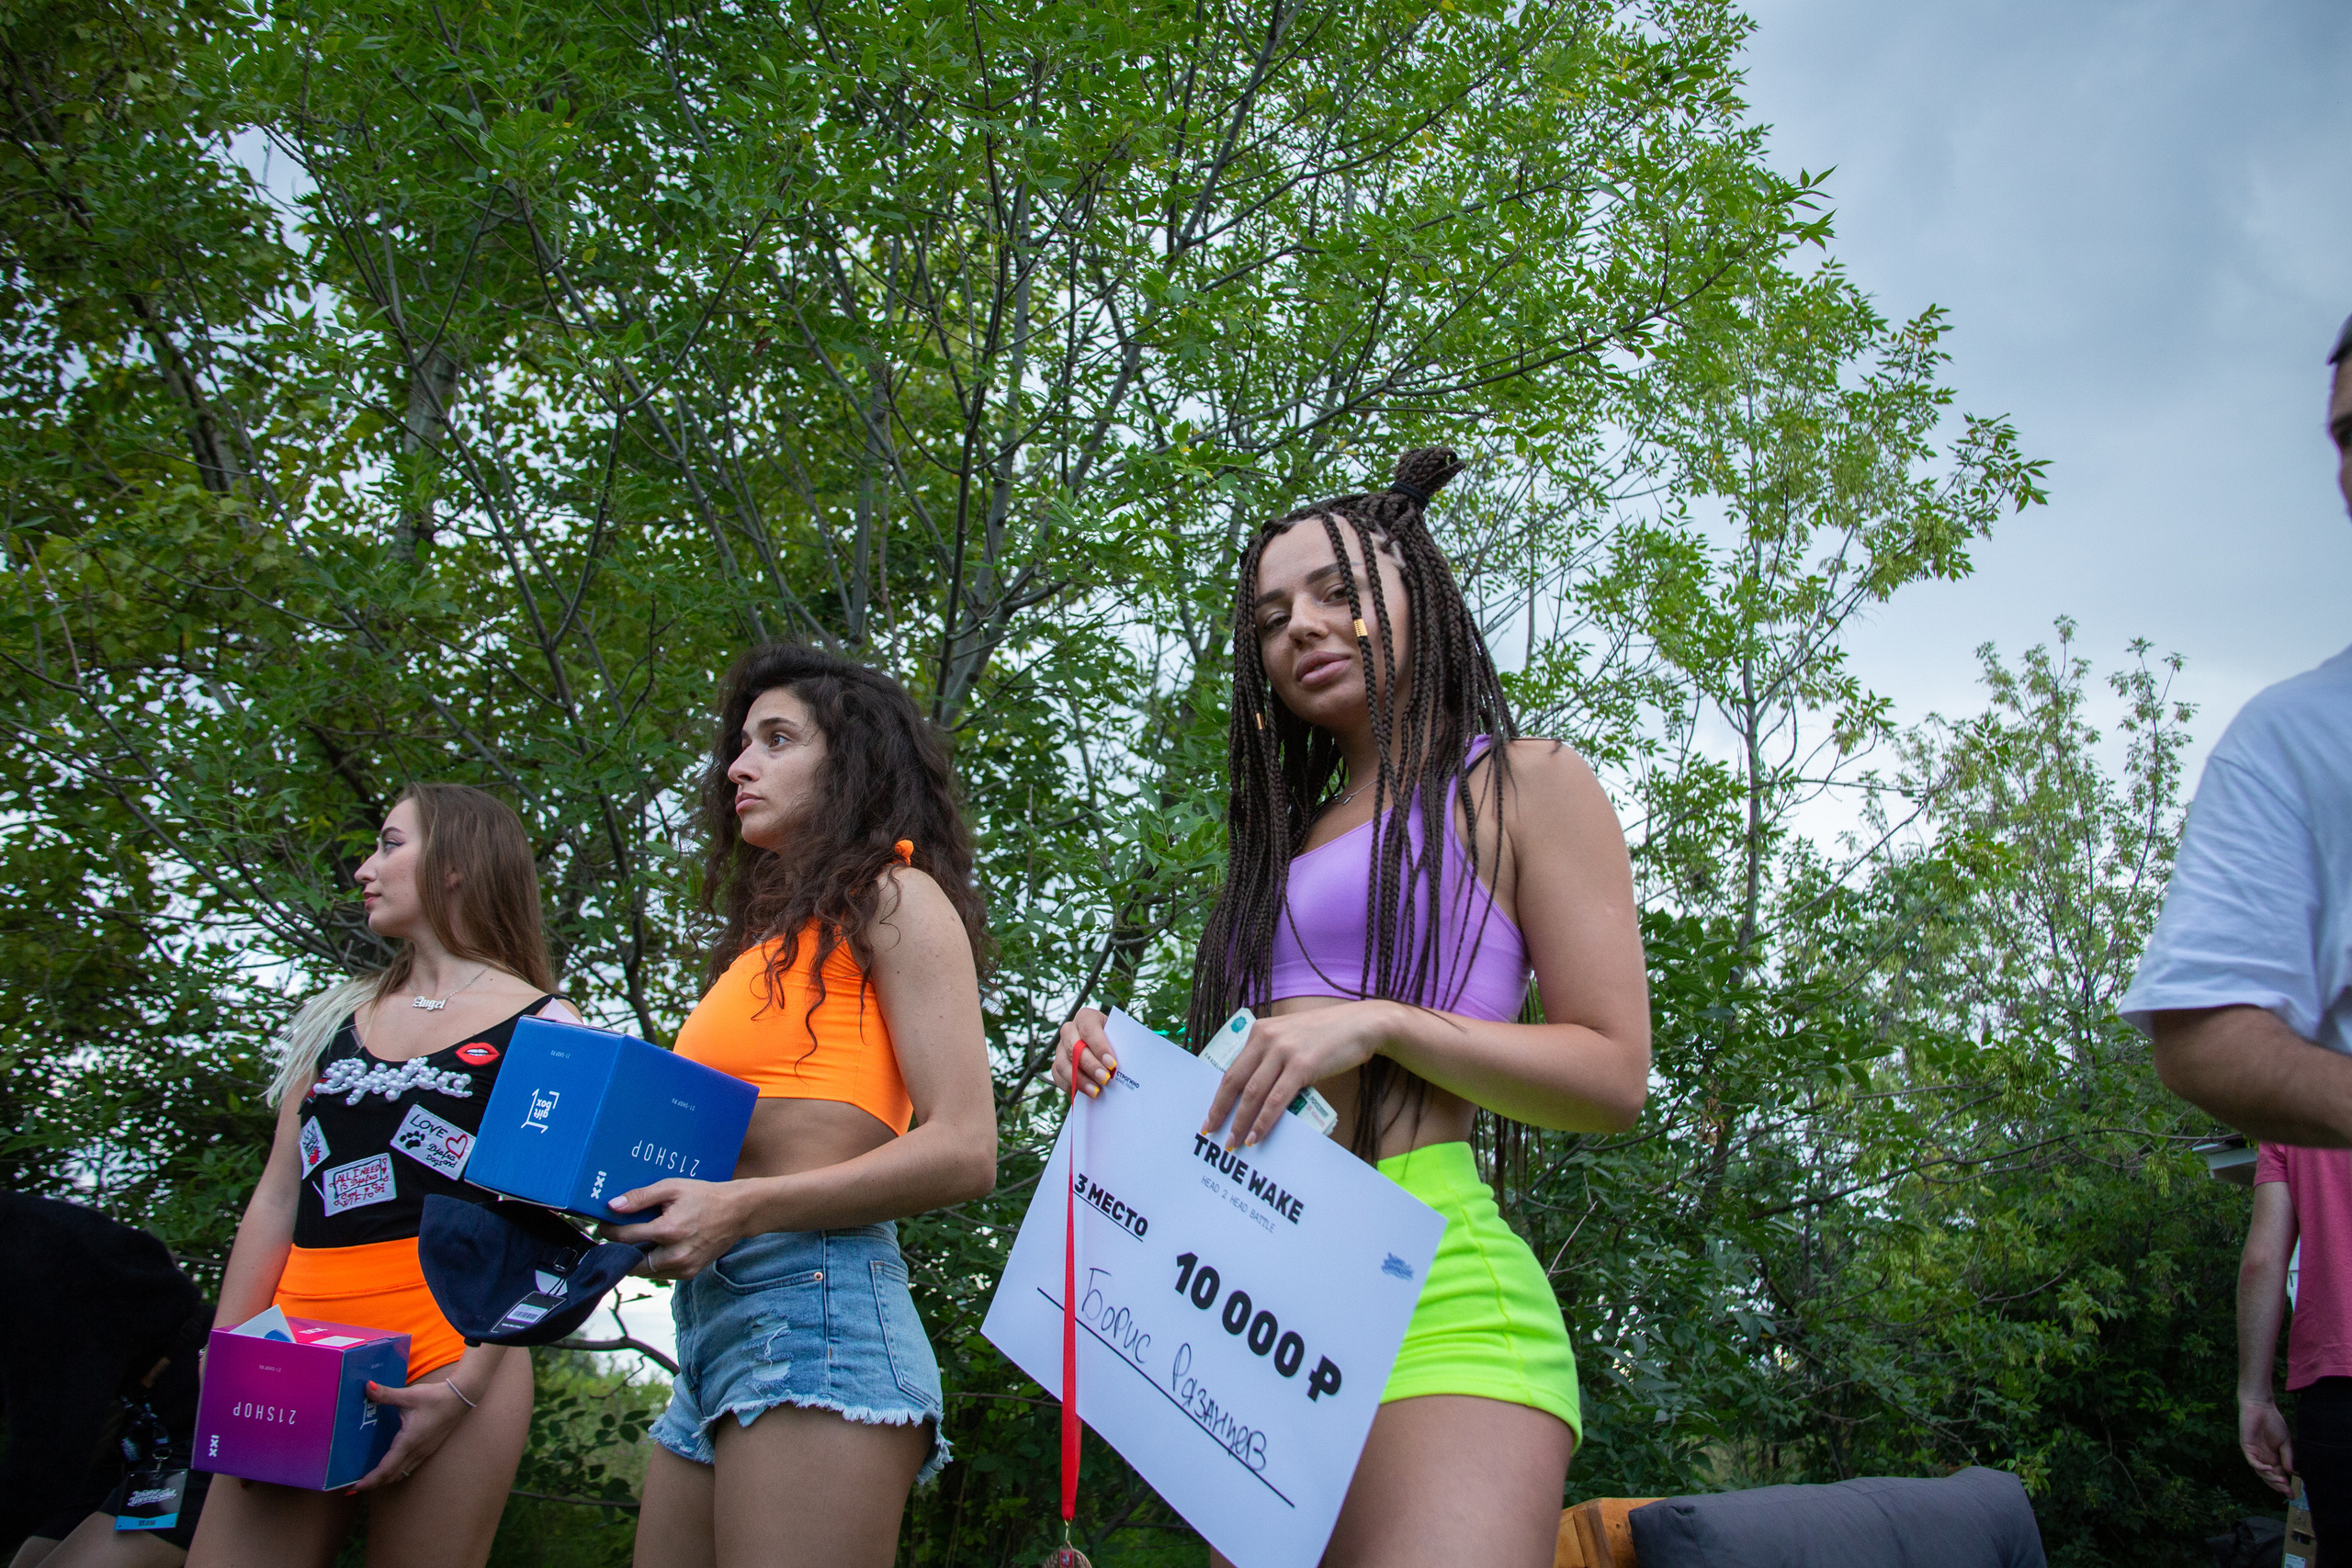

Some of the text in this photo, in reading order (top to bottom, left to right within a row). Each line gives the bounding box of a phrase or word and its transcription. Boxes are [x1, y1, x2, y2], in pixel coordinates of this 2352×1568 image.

[412, 995, 447, 1010] Angel
[1115, 1070, 1140, 1089] СТРОГИНО
[533, 1108, 549, 1121] gift
[536, 1098, 553, 1111] box
[410, 1113, 448, 1139] LOVE
[631, 1140, 700, 1177] 21SHOP
[336, 1164, 380, 1183] ALL I NEED
[590, 1170, 607, 1200] XXI
[1193, 1133, 1304, 1225] TRUE WAKE
[1074, 1172, 1148, 1237] 3 МЕСТО
[1201, 1175, 1276, 1233] HEAD 2 HEAD BATTLE
[1081, 1267, 1150, 1364] Борис
[1174, 1251, 1220, 1310] 10
[1222, 1290, 1305, 1378] 000
[232, 1402, 297, 1425] 21SHOP
[208, 1434, 220, 1458] XXI
